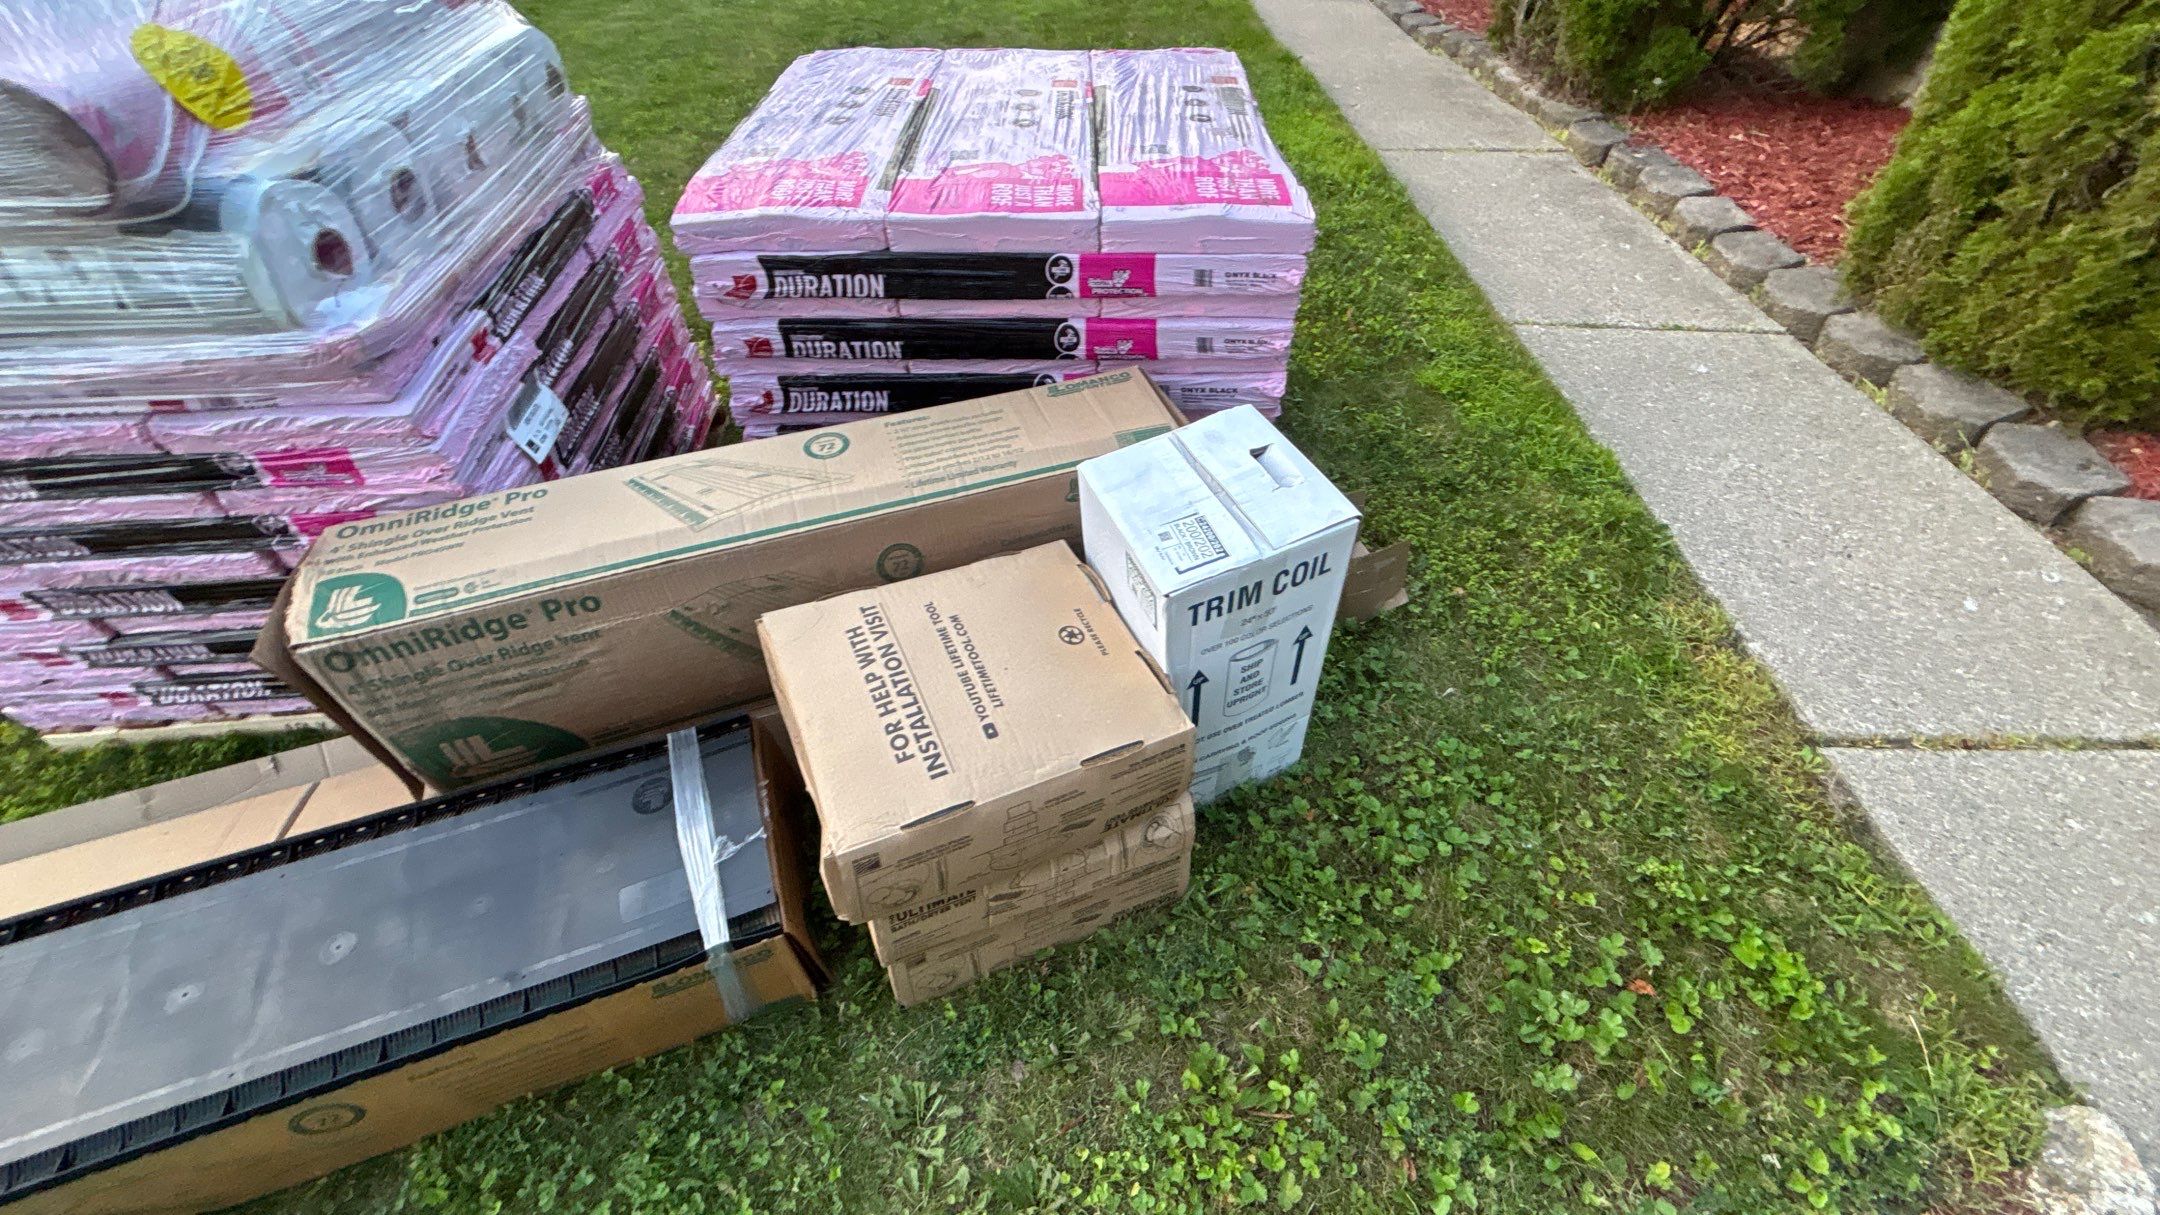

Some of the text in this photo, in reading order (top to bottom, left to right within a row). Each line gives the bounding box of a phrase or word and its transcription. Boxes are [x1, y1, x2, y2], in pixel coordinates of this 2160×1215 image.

[991, 183, 1014, 206] ROOF
[1033, 184, 1054, 208] THAN
[1055, 183, 1075, 207] MORE
[1194, 176, 1219, 199] ROOF
[774, 273, 886, 299] DURATION
[1224, 271, 1277, 279] ONYX BLACK
[791, 341, 902, 360] DURATION
[787, 390, 890, 413] DURATION
[818, 442, 836, 452] 72
[505, 488, 548, 505] Pro
[348, 534, 407, 552] Shingle
[411, 524, 448, 539] Over
[453, 513, 497, 531] Ridge
[500, 506, 535, 520] Vent
[1182, 519, 1215, 559] 200/202
[1187, 580, 1264, 627] TRIM
[1272, 551, 1332, 597] COIL
[541, 595, 602, 622] Pro
[860, 604, 890, 645] VISIT
[1200, 604, 1314, 655] OVER 100 COLOR SELECTIONS
[363, 664, 445, 690] Shingle
[447, 654, 494, 673] Over
[497, 638, 552, 660] Ridge
[923, 601, 988, 722] YOUTUBE LIFETIME TOOL
[948, 614, 1004, 708] LIFETIMETOOL.COM
[1241, 658, 1264, 673] SHIP
[1233, 678, 1264, 696] STORE
[1241, 670, 1260, 683] AND
[845, 627, 917, 765] FOR HELP WITH
[1226, 685, 1268, 708] UPRIGHT
[875, 644, 950, 781] INSTALLATION
[1223, 721, 1244, 734] OVER
